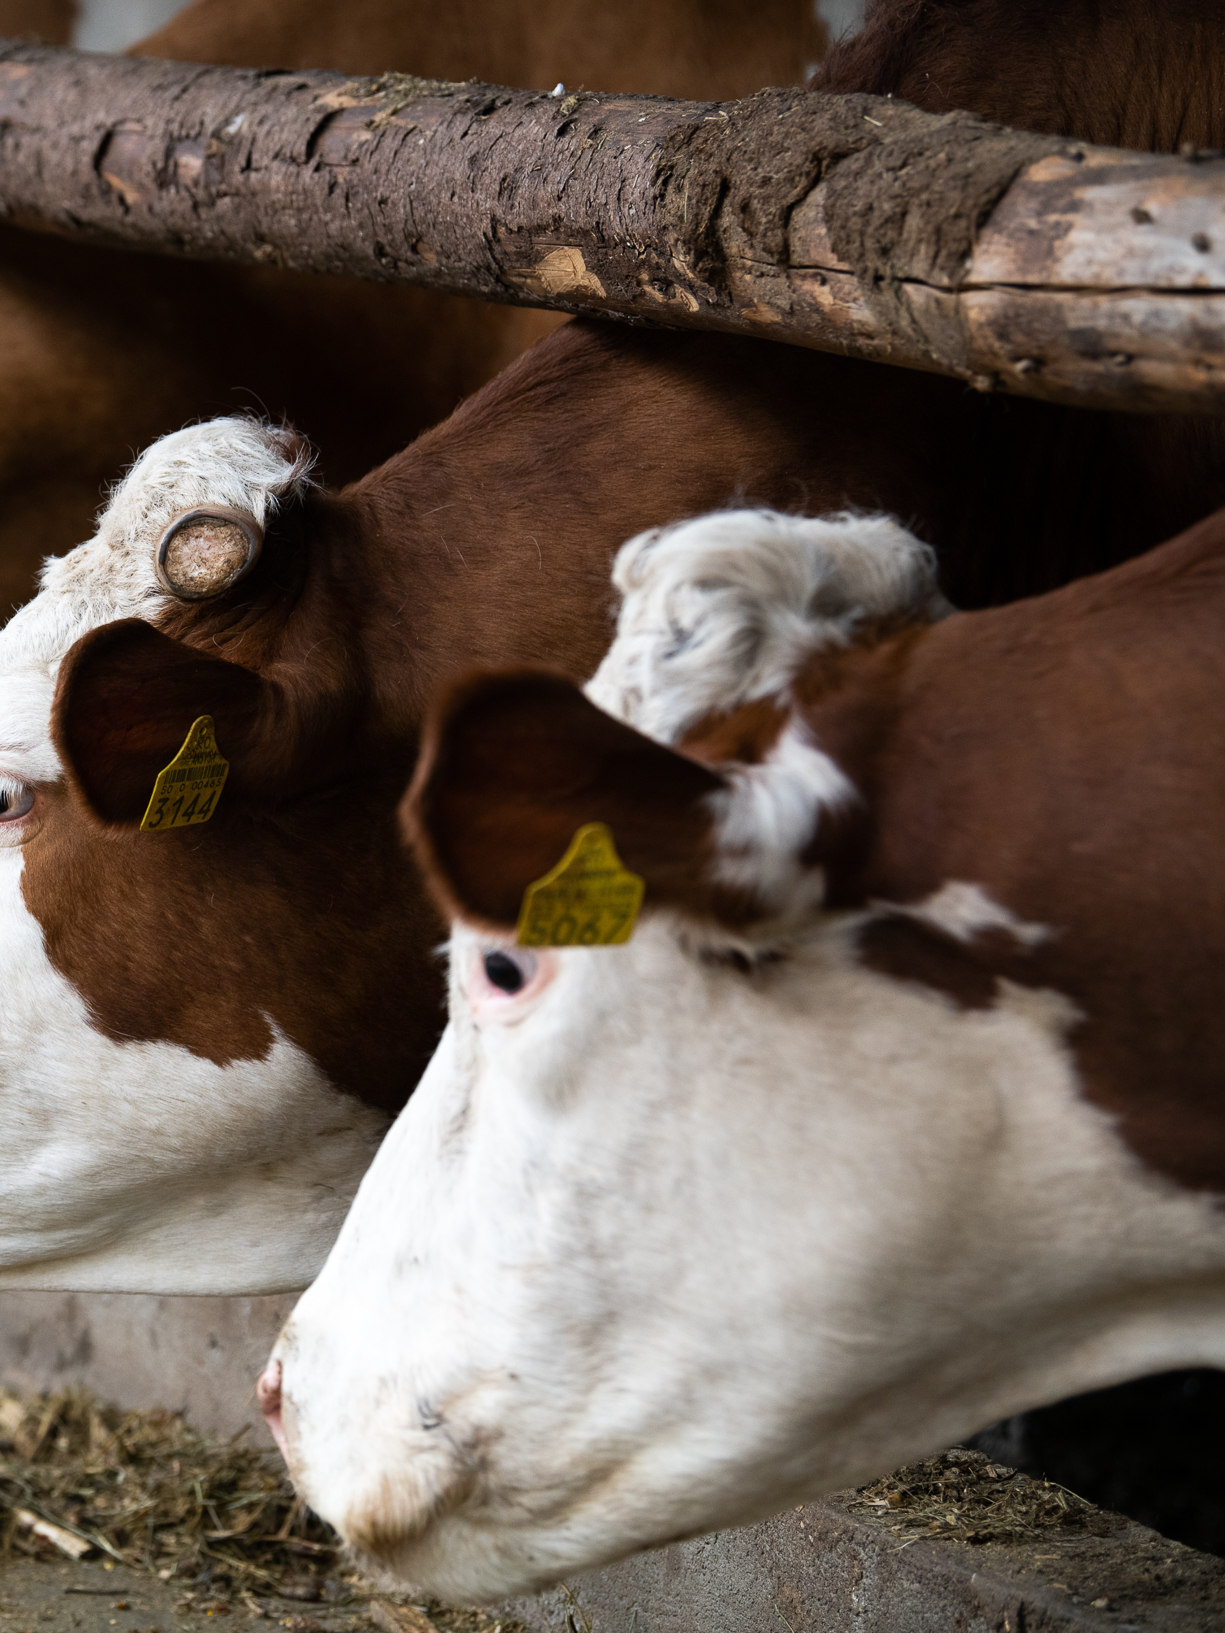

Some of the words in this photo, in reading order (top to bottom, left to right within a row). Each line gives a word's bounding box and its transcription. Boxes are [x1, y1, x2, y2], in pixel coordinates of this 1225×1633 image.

[197, 737, 211, 749] RO
[149, 791, 216, 828] 3144
[526, 908, 631, 946] 5067
